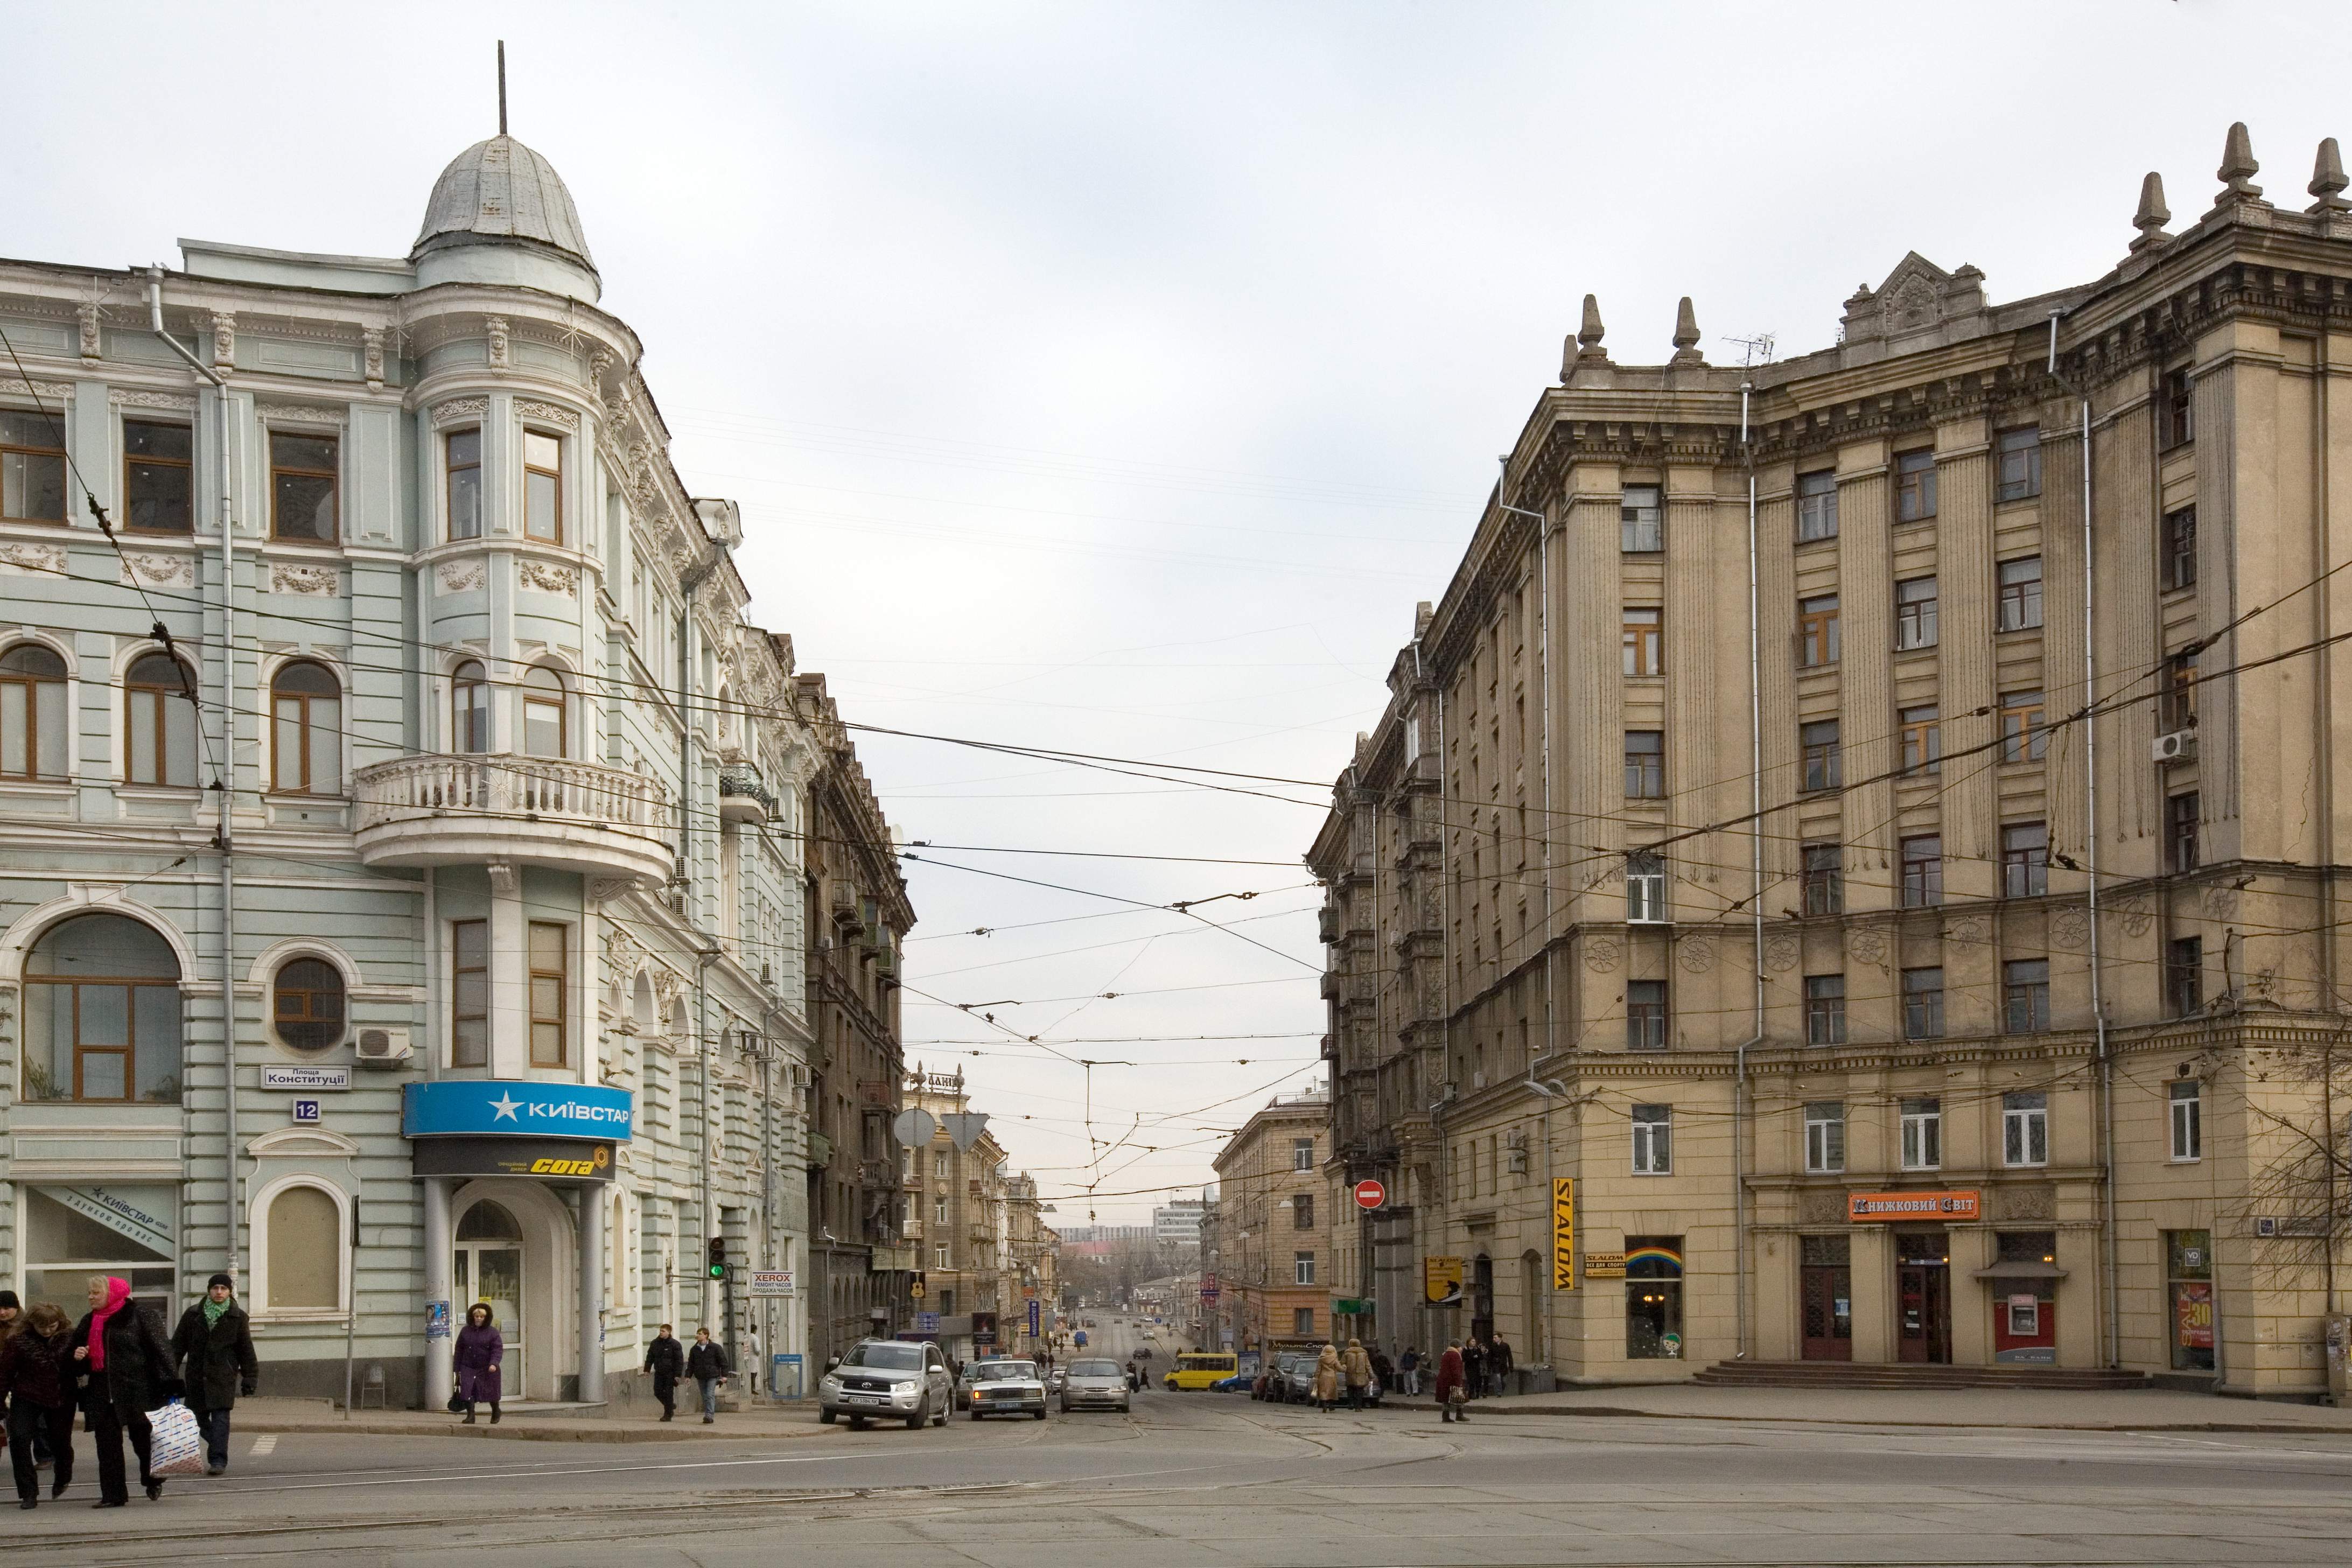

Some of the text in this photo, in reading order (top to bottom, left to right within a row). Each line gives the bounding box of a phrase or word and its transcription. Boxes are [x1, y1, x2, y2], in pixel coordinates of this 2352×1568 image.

[268, 1074, 345, 1085] Конституції
[297, 1104, 316, 1117] 12
[529, 1101, 629, 1124] КИЇВСТАР
[74, 1200, 112, 1222] думкою
[115, 1220, 132, 1233] про
[135, 1230, 152, 1242] вас
[102, 1195, 169, 1230] КИЇВСТАР GSM
[1557, 1179, 1570, 1290] SLALOM
[2192, 1303, 2211, 1327] 30
